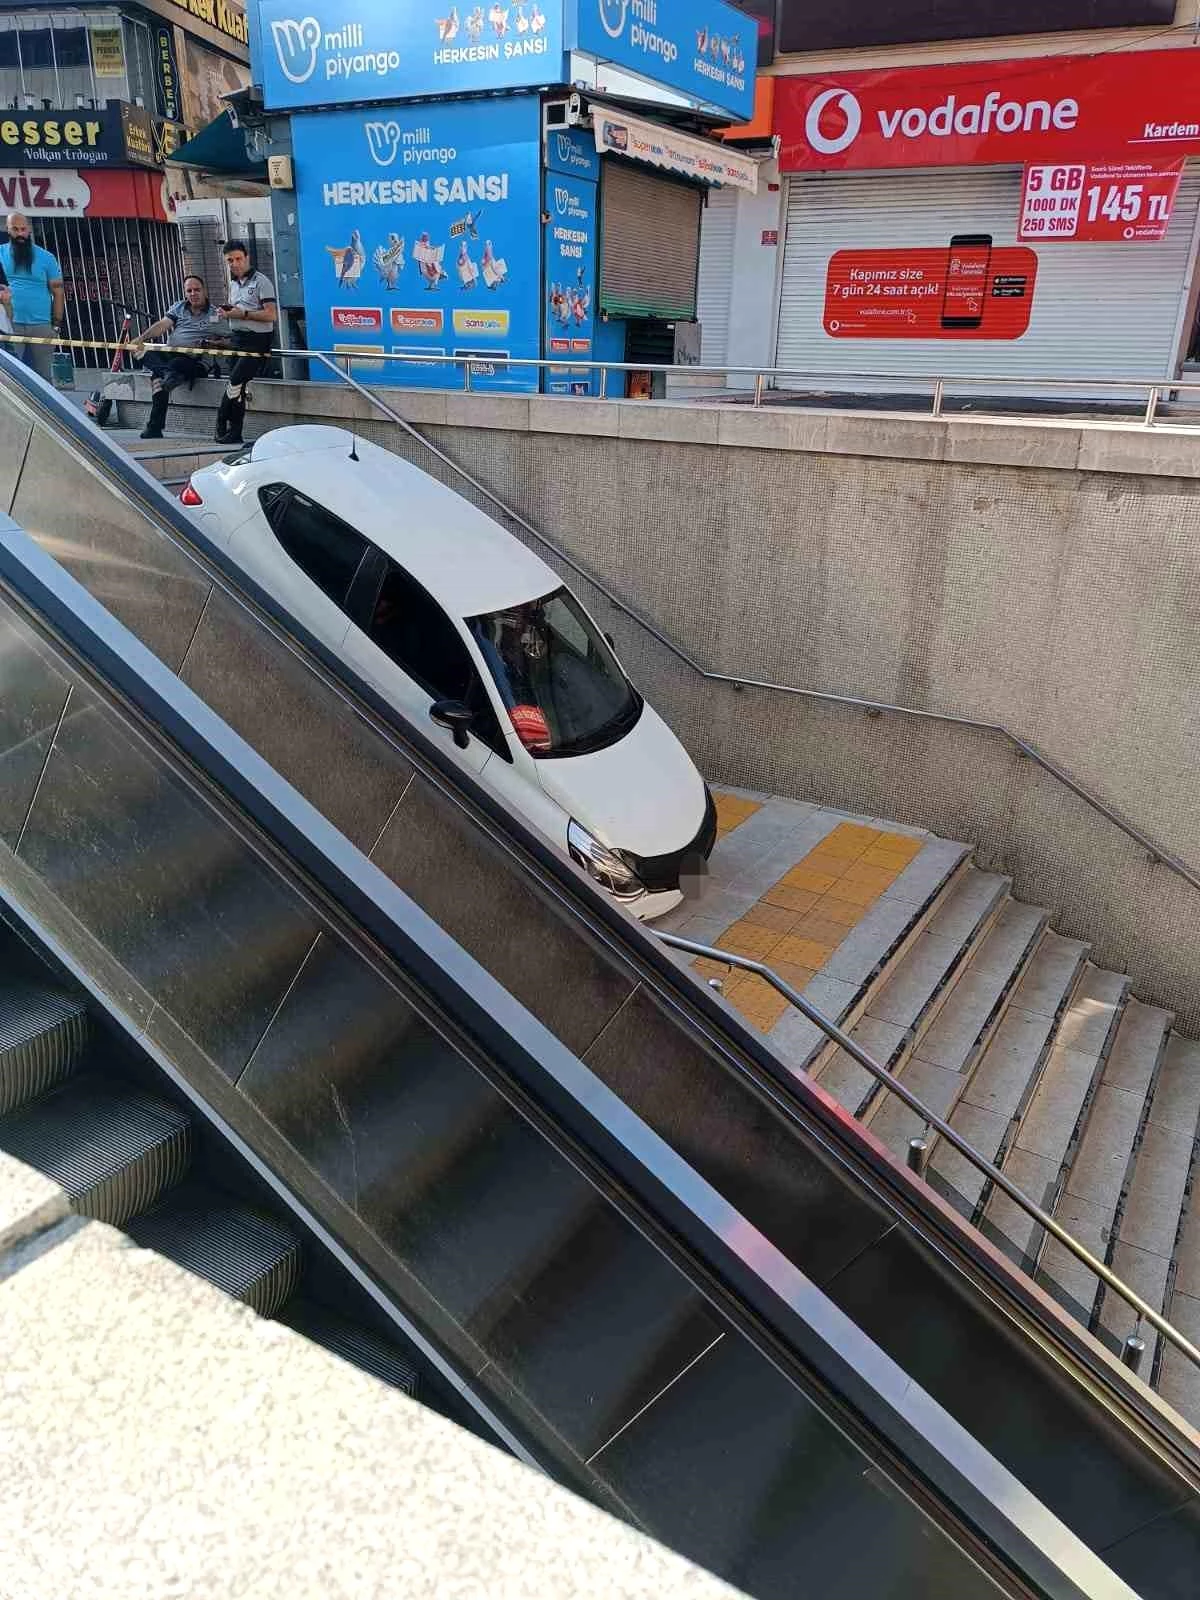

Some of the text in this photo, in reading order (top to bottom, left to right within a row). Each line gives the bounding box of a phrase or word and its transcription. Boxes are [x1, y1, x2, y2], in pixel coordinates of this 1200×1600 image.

[325, 24, 363, 49] milli
[631, 23, 678, 62] piyango
[503, 37, 548, 60] ŞANSI
[326, 50, 400, 80] piyango
[878, 92, 1079, 138] vodafone
[0, 120, 100, 146] esser
[402, 127, 431, 145] milli
[1143, 121, 1199, 138] Kardem
[25, 148, 61, 162] Volkan
[403, 147, 456, 165] piyango
[433, 174, 509, 204] ŞANSI
[1029, 168, 1082, 191] 5 GB
[1027, 197, 1078, 212] 1000 DK
[1088, 185, 1169, 222] 145 TL
[1023, 217, 1075, 232] 250 SMS
[850, 267, 924, 283] Kapımız size
[832, 284, 841, 295] 7
[842, 283, 865, 298] gün
[866, 284, 881, 296] 24
[882, 284, 907, 296] saat
[911, 283, 939, 298] açık!
